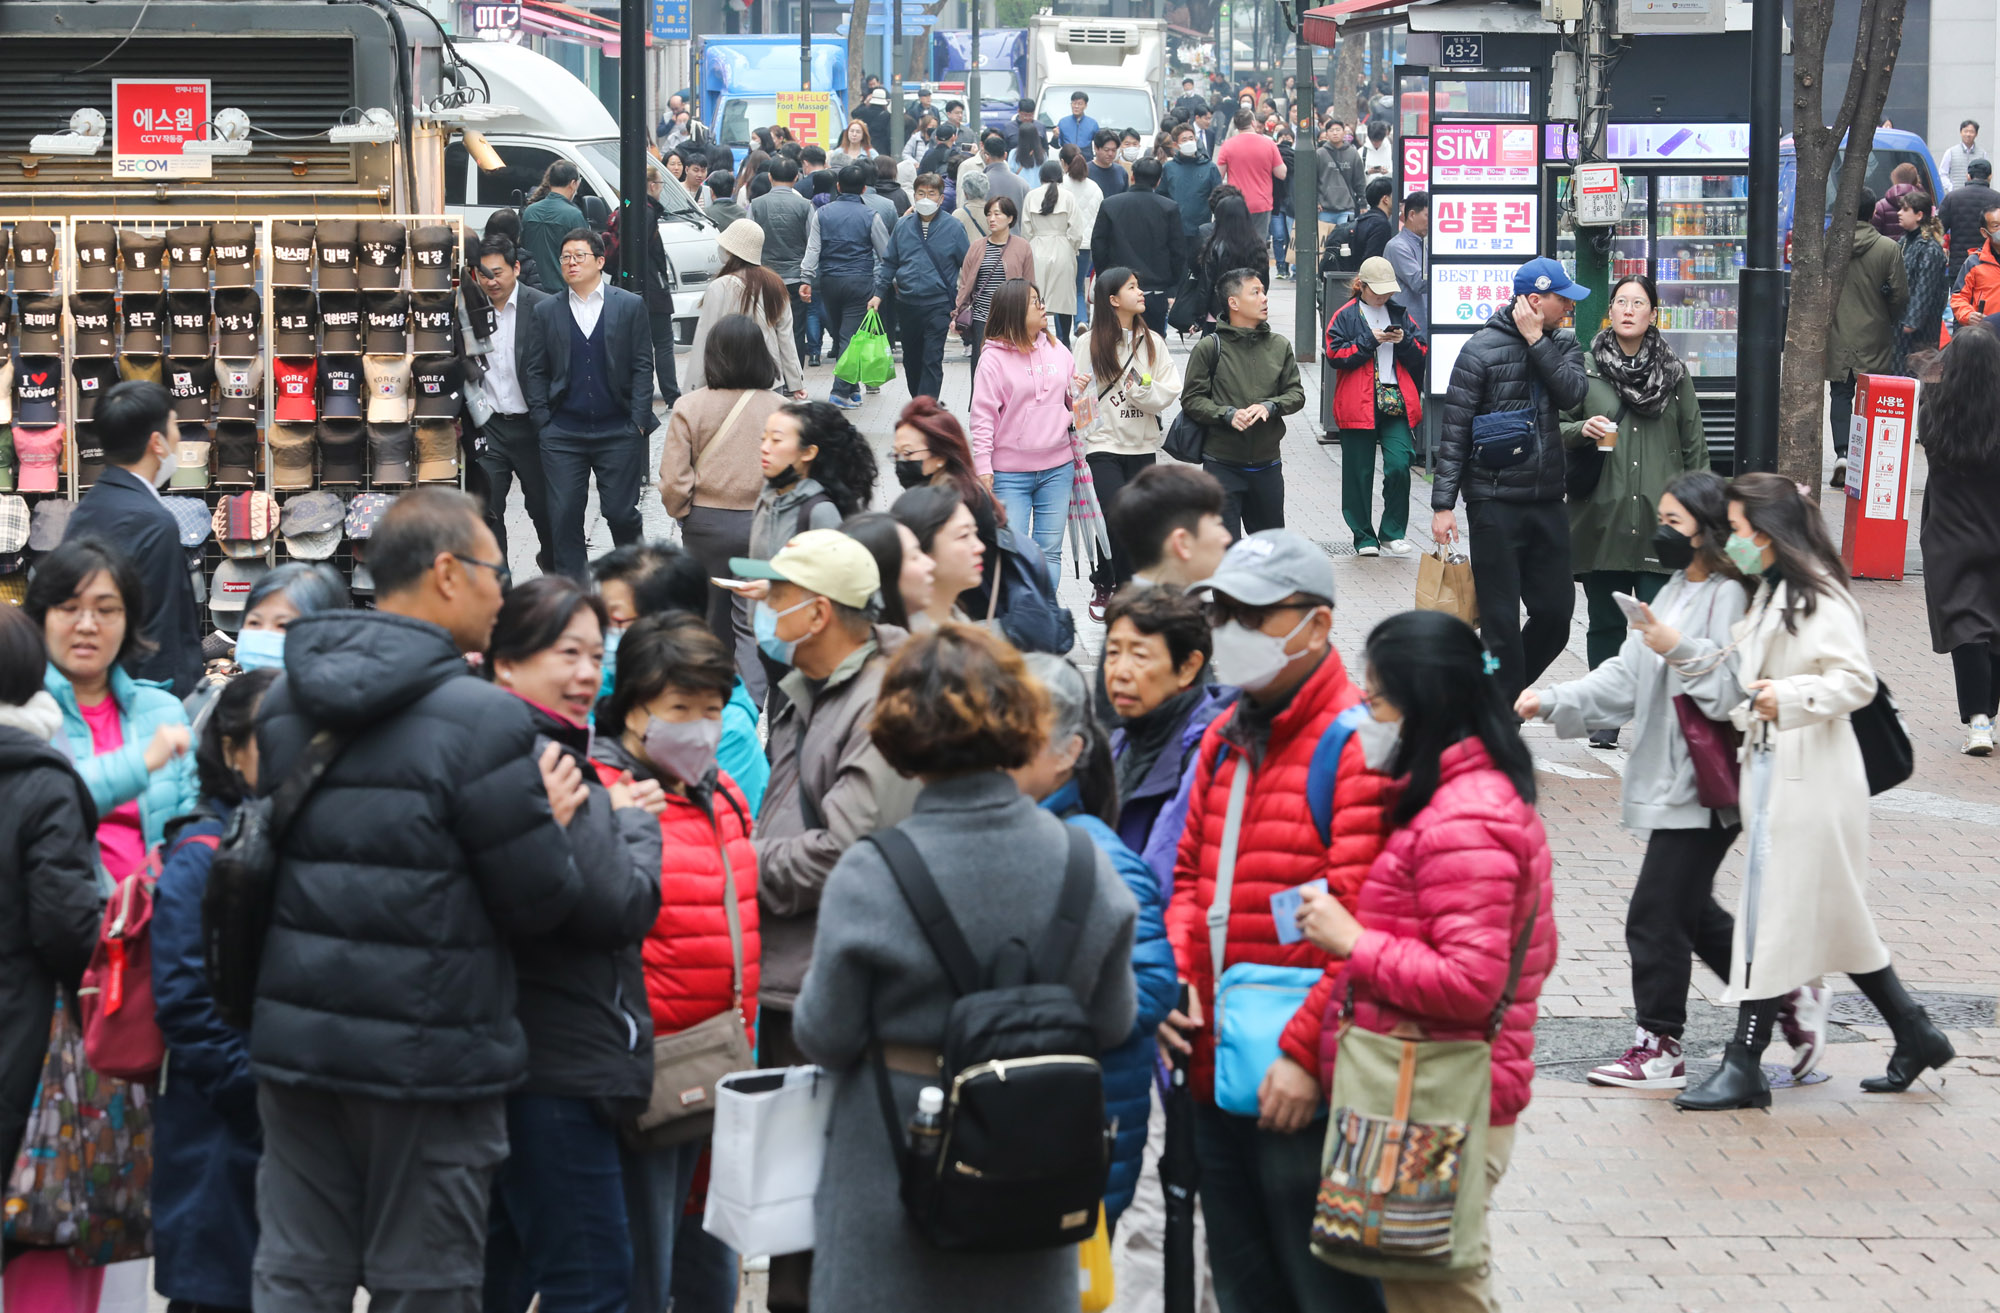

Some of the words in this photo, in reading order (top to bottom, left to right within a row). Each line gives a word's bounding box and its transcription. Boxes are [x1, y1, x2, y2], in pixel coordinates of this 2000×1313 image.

[1445, 44, 1479, 58] 43-2
[797, 93, 829, 103] HELLO
[798, 103, 829, 111] Massage
[133, 108, 193, 131] 에스원
[140, 135, 161, 143] CCTV
[163, 135, 184, 143] 작동중
[1436, 135, 1489, 161] SIM
[118, 160, 167, 172] SECOM
[1438, 202, 1531, 233] 상품권
[1456, 239, 1478, 249] 사고
[1491, 239, 1513, 249] 팔고
[215, 245, 247, 259] 꽃미남
[323, 248, 350, 263] 대박
[371, 250, 387, 265] 왕
[417, 250, 443, 264] 대장
[1438, 269, 1479, 282] BEST
[129, 312, 156, 327] 친구
[173, 315, 203, 328] 외국인
[281, 316, 308, 329] 최고
[323, 312, 359, 326] 대한민국
[22, 375, 30, 386] I
[281, 373, 309, 384] KOREA
[328, 371, 355, 380] KOREA
[373, 376, 401, 384] KOREA
[418, 374, 445, 382] KOREA
[18, 386, 55, 398] Korea
[1877, 395, 1905, 407] 사용법
[1120, 409, 1144, 418] PARIS
[223, 582, 250, 592] Supreme
